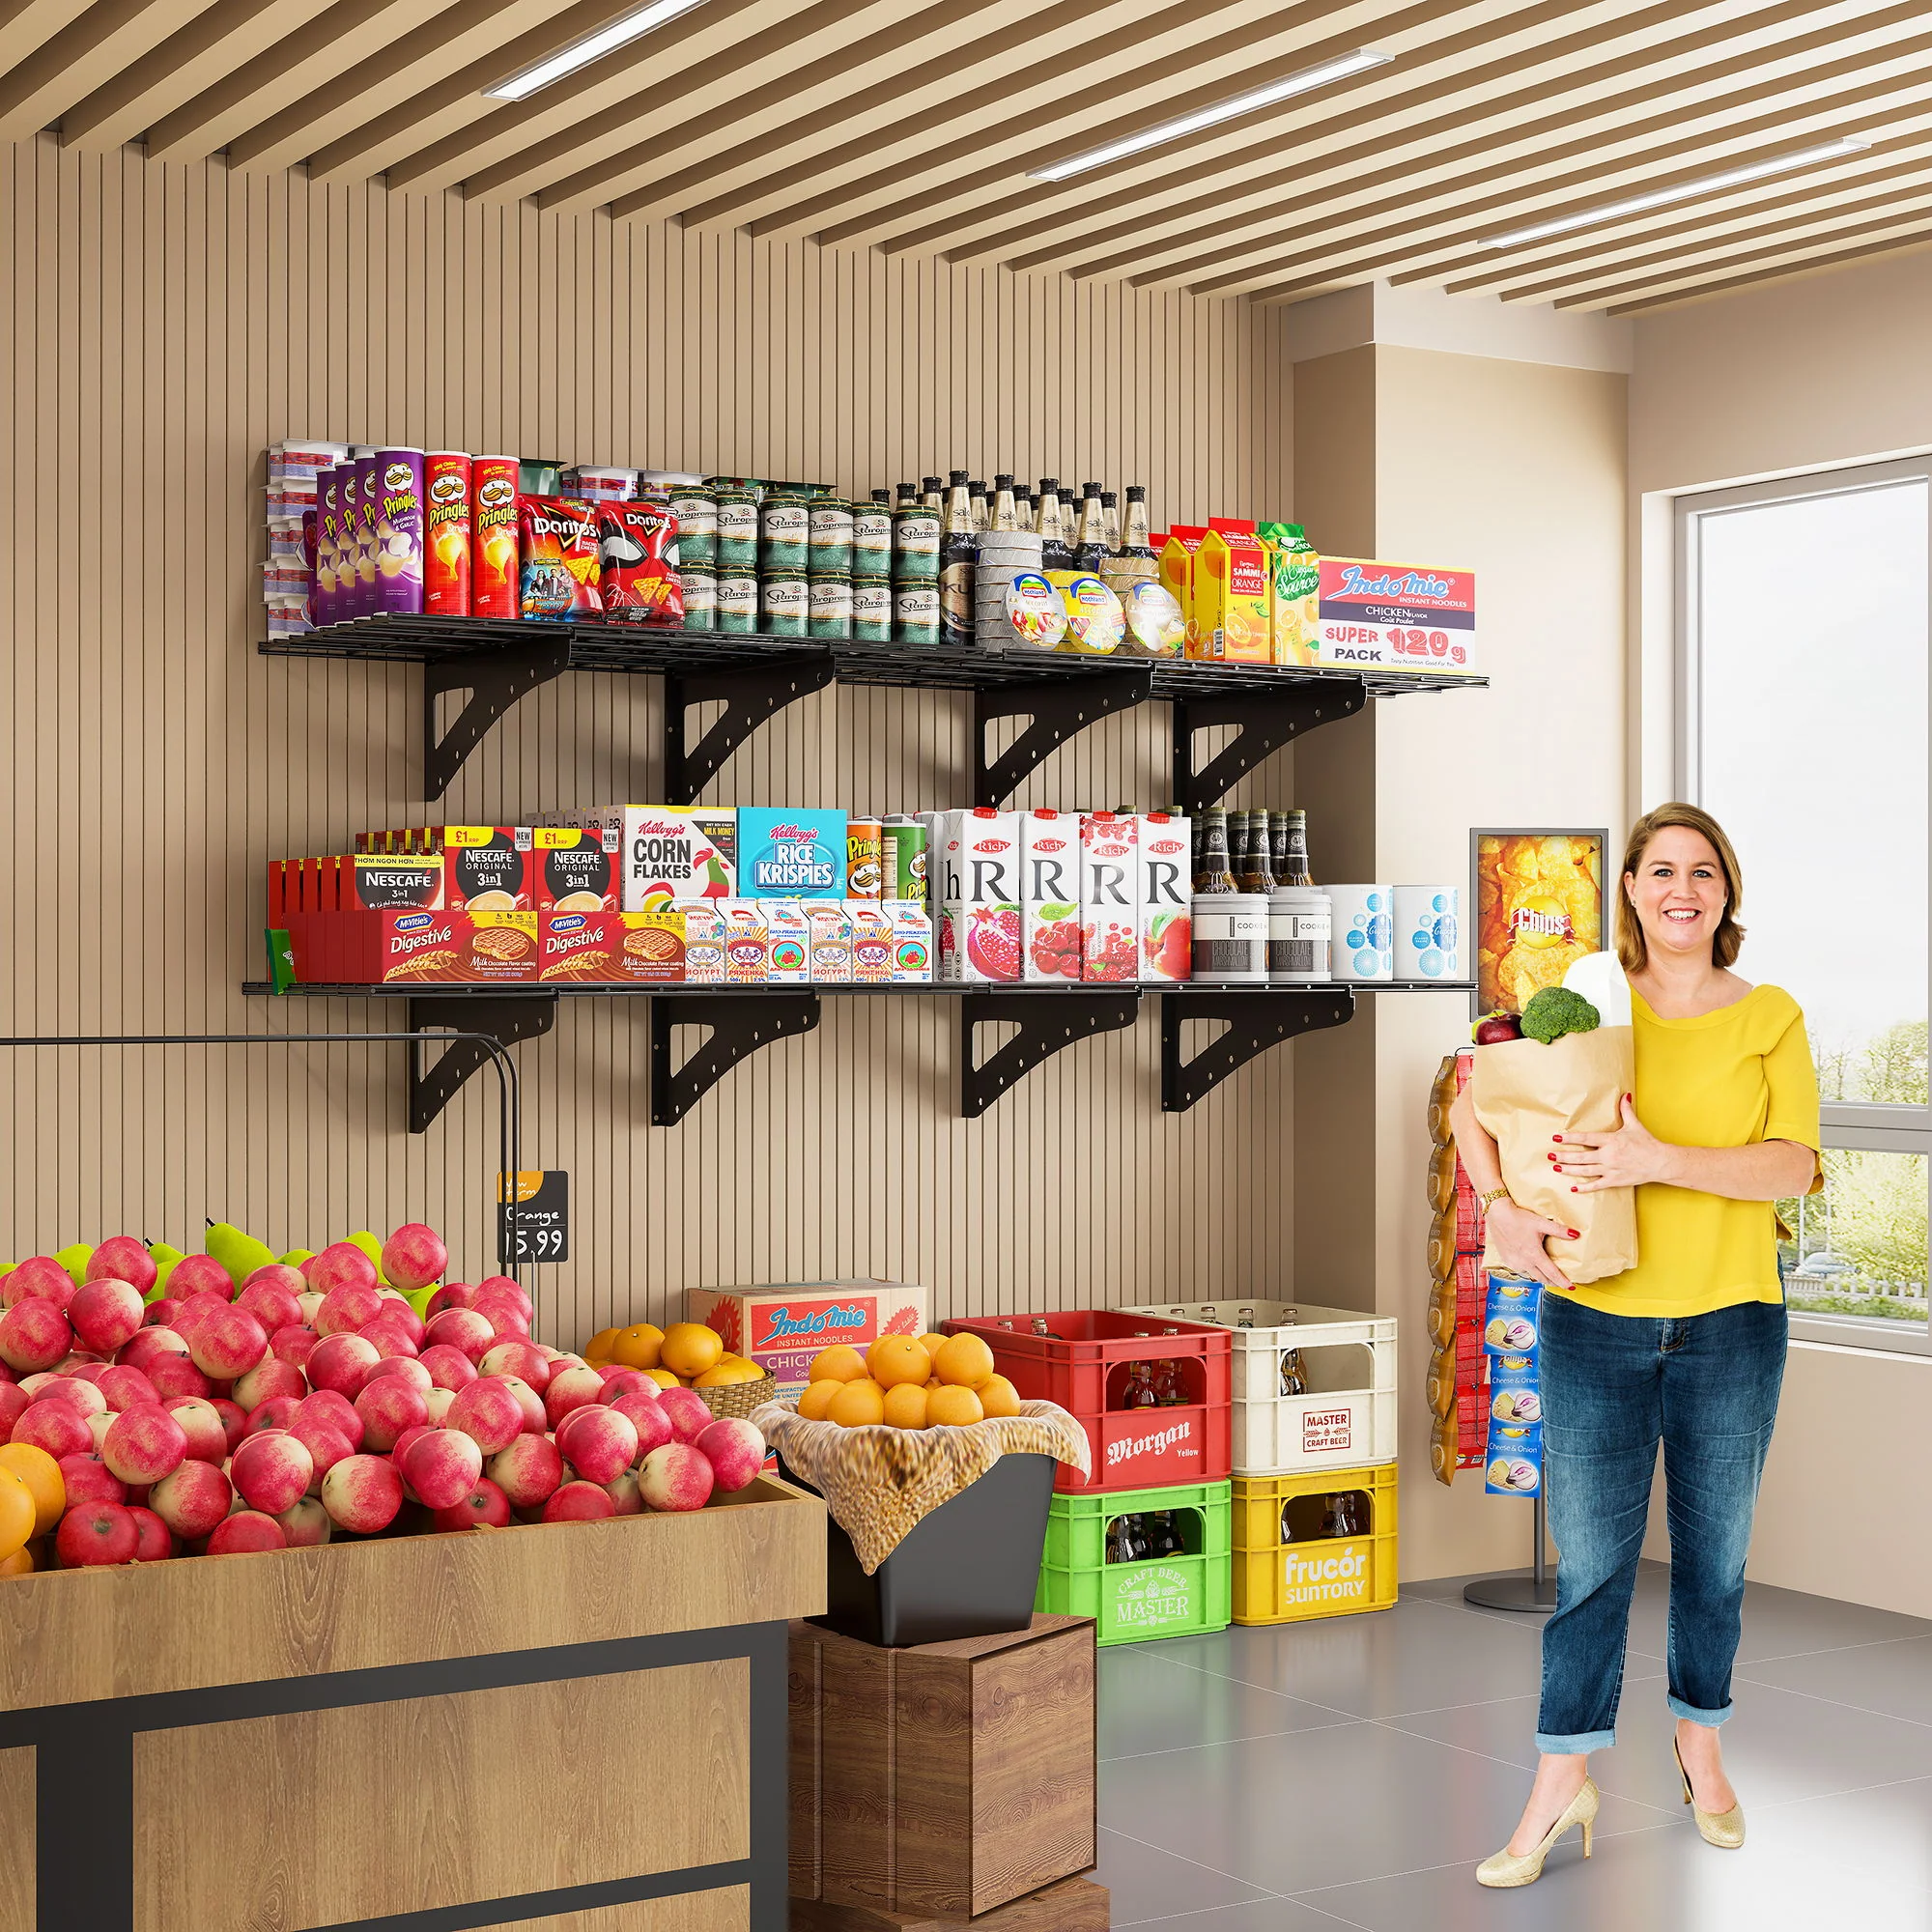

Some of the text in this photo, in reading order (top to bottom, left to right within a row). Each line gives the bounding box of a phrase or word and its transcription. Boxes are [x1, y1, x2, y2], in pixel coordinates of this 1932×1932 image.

[383, 489, 418, 521] Pringles
[429, 499, 469, 531] Pringles
[477, 503, 519, 535] Pringles
[626, 513, 671, 529] Doritos
[533, 518, 597, 537] Doritos
[1232, 579, 1263, 589] ORANGE
[1275, 574, 1319, 597] Source
[1365, 606, 1410, 617] CHICKEN
[1432, 599, 1467, 608] NOODLES
[1325, 627, 1378, 643] SUPER
[1334, 648, 1382, 661] PACK
[455, 831, 469, 843] £1
[516, 832, 531, 840] NEW
[638, 820, 686, 838] Kellogg's
[718, 827, 734, 837] MONEY
[770, 824, 819, 842] Kellogg's
[544, 832, 556, 844] £1
[603, 834, 617, 842] NEW
[978, 839, 1007, 852] Rich
[1037, 839, 1065, 852] Rich
[1152, 839, 1180, 853] Rich
[634, 838, 692, 863] CORN
[777, 843, 814, 865] RICE
[1098, 844, 1126, 857] Rich
[634, 865, 692, 879] FLAKES
[755, 862, 835, 888] KRISPIES
[1031, 859, 1069, 901] R
[970, 860, 1011, 901] R
[1090, 864, 1131, 904] R
[1146, 861, 1186, 904] R
[1518, 906, 1566, 938] Chips
[390, 924, 452, 953] Digestive
[545, 925, 604, 954] Digestive
[1212, 941, 1249, 955] CHOCOLATE
[1275, 941, 1312, 955] CHOCOLATE
[1488, 1302, 1509, 1311] Cheese
[777, 1335, 853, 1349] INSTANT NOODLES
[767, 1354, 814, 1370] CHICK
[1307, 1413, 1348, 1428] MASTER
[1106, 1421, 1192, 1466] Morgan
[1307, 1435, 1348, 1448] CRAFT BEER
[1489, 1442, 1511, 1451] Cheese
[1518, 1445, 1538, 1454] Onion
[1177, 1447, 1199, 1459] Yellow
[1118, 1566, 1189, 1594] CRAFT BEER
[1117, 1597, 1189, 1624] MASTER
